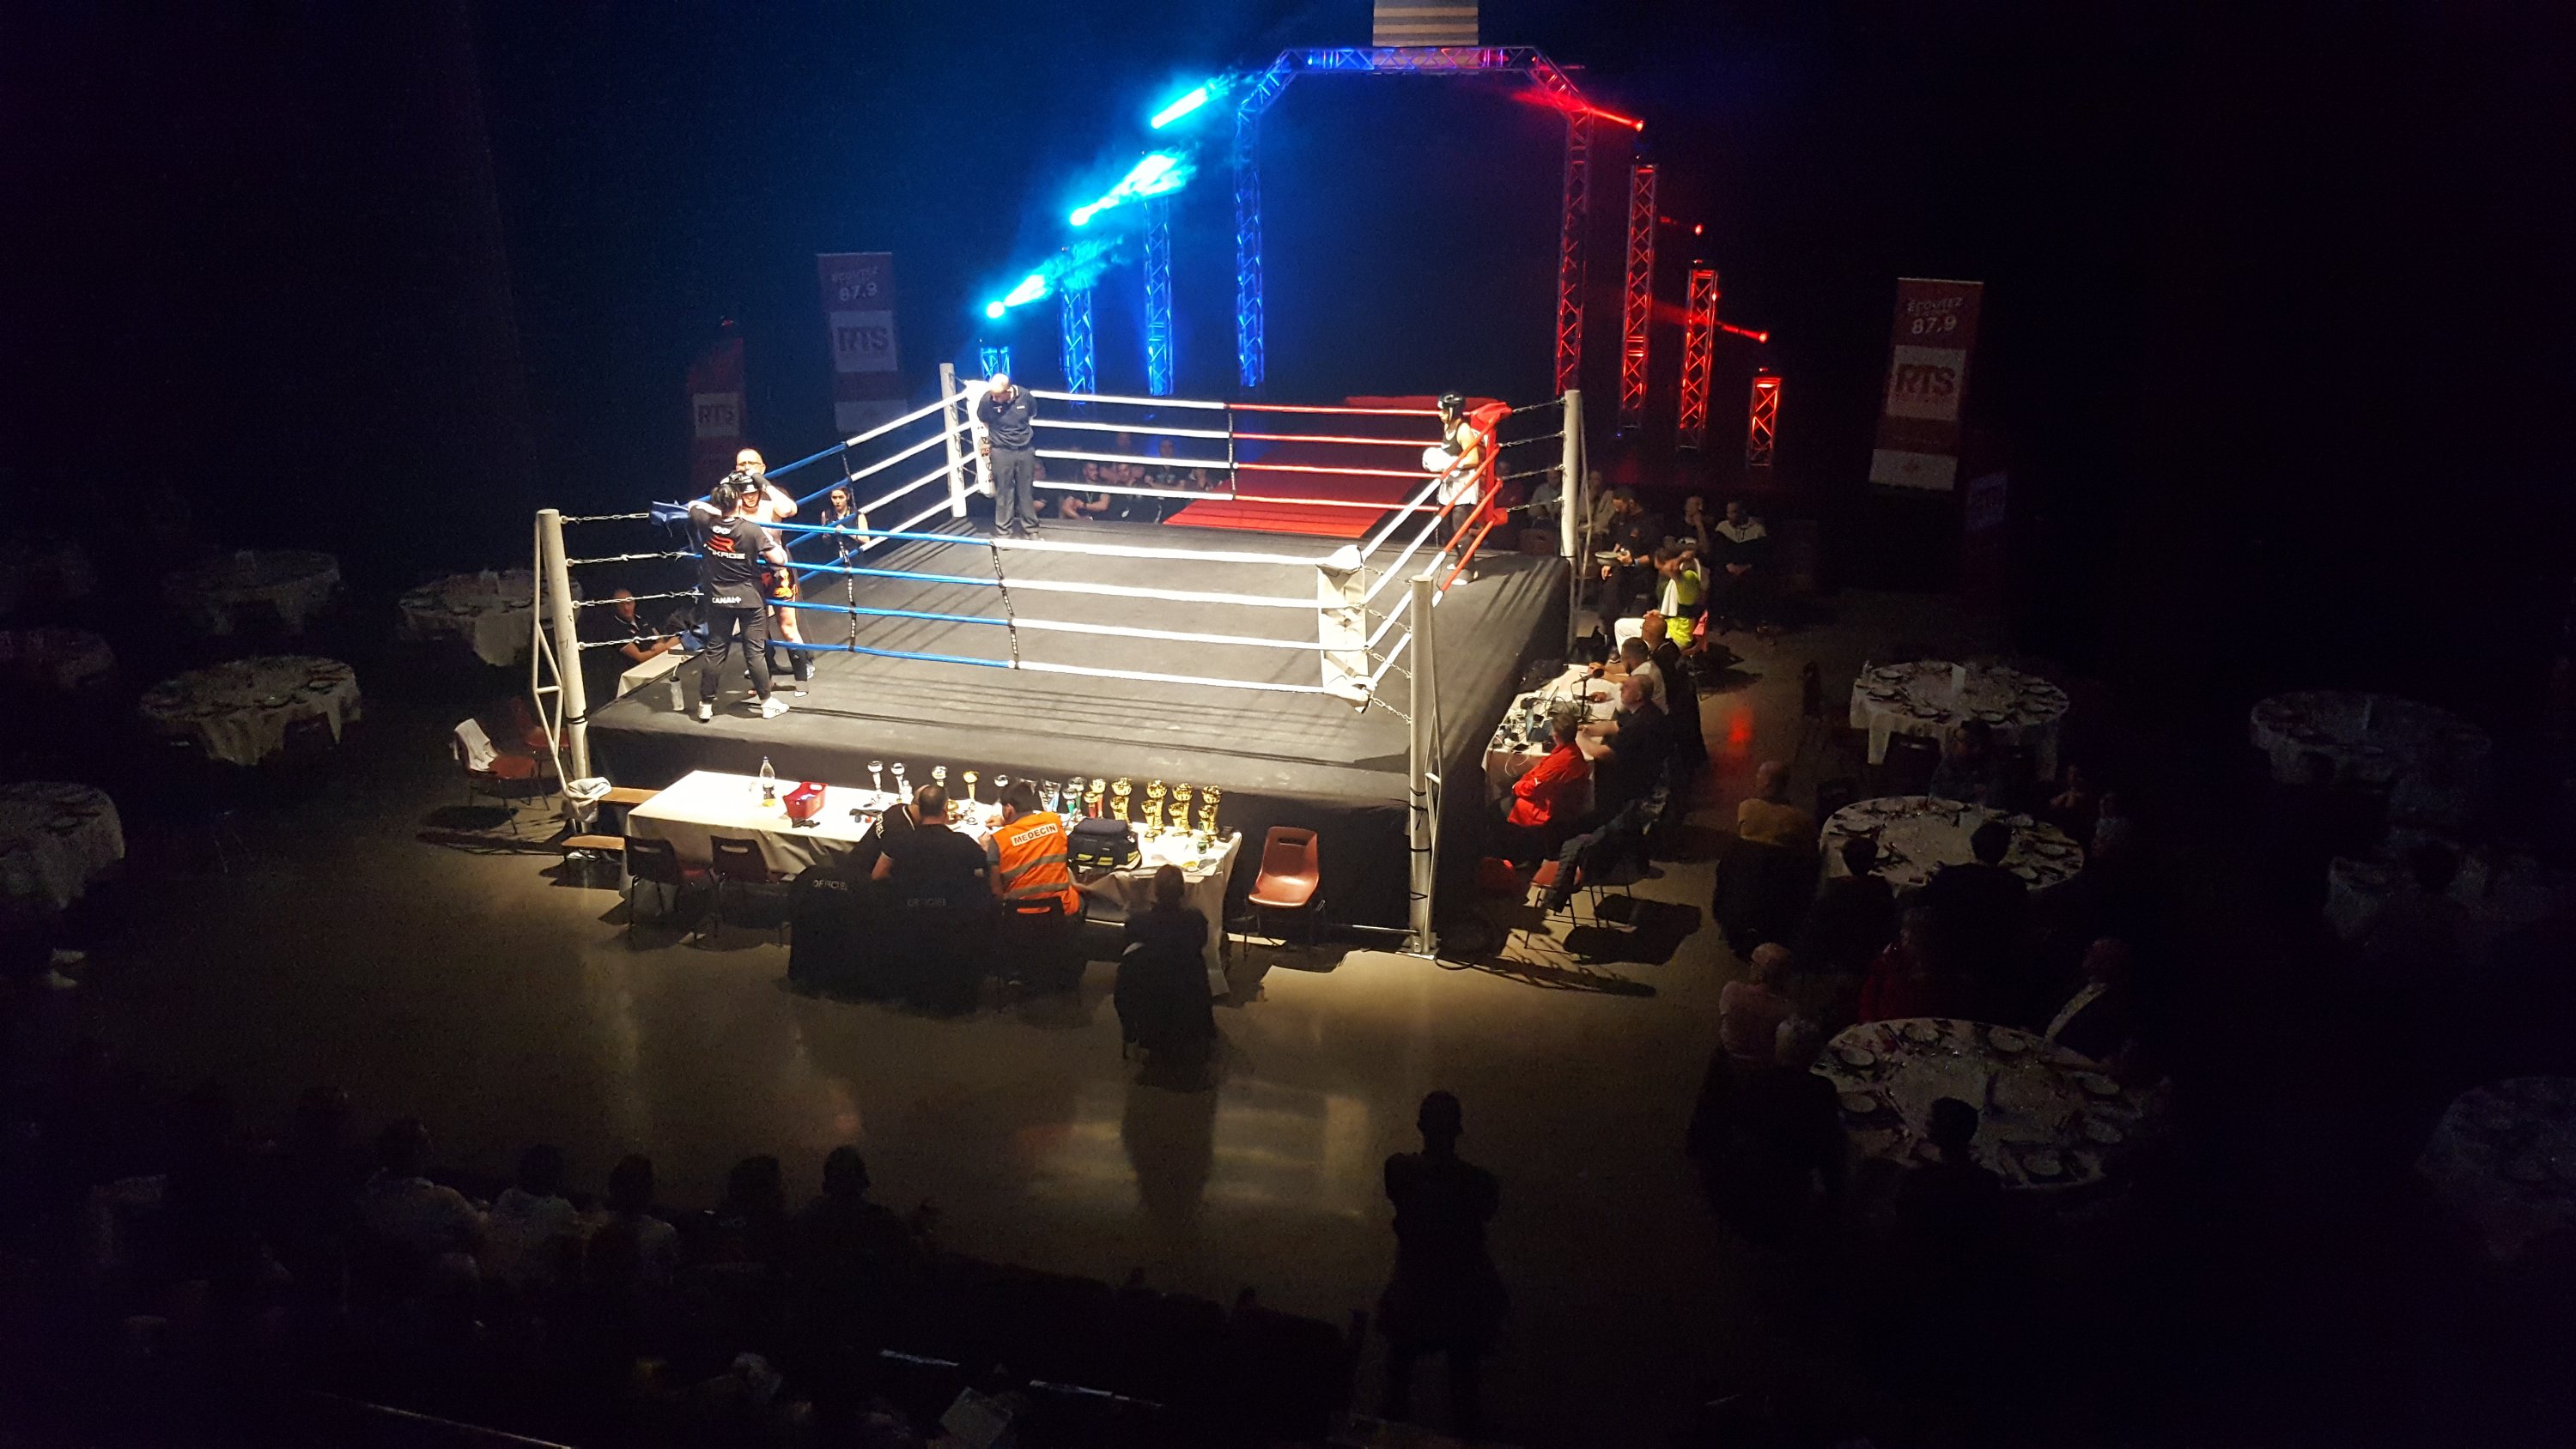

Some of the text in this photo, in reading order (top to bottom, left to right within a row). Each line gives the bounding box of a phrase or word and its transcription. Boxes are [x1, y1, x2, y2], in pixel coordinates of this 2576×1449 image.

[836, 326, 890, 353] RTS
[1895, 363, 1956, 396] RTS
[1013, 825, 1056, 845] MEDECIN
